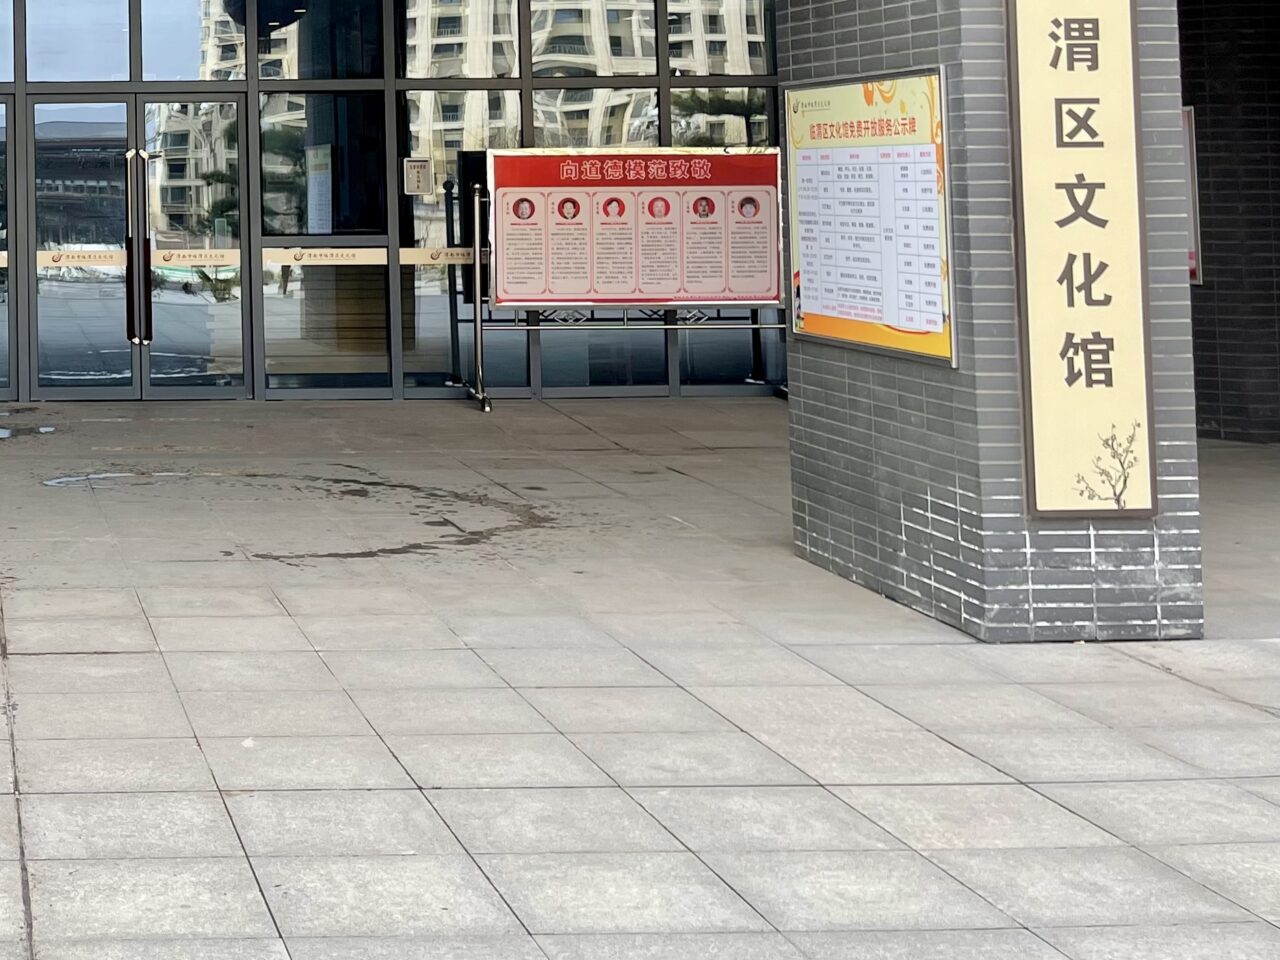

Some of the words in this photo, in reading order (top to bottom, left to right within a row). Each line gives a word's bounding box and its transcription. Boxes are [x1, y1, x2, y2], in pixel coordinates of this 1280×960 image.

[809, 117, 917, 140] 临渭区文化馆免费开放服务公示牌
[560, 159, 712, 180] 向道德模范致敬
